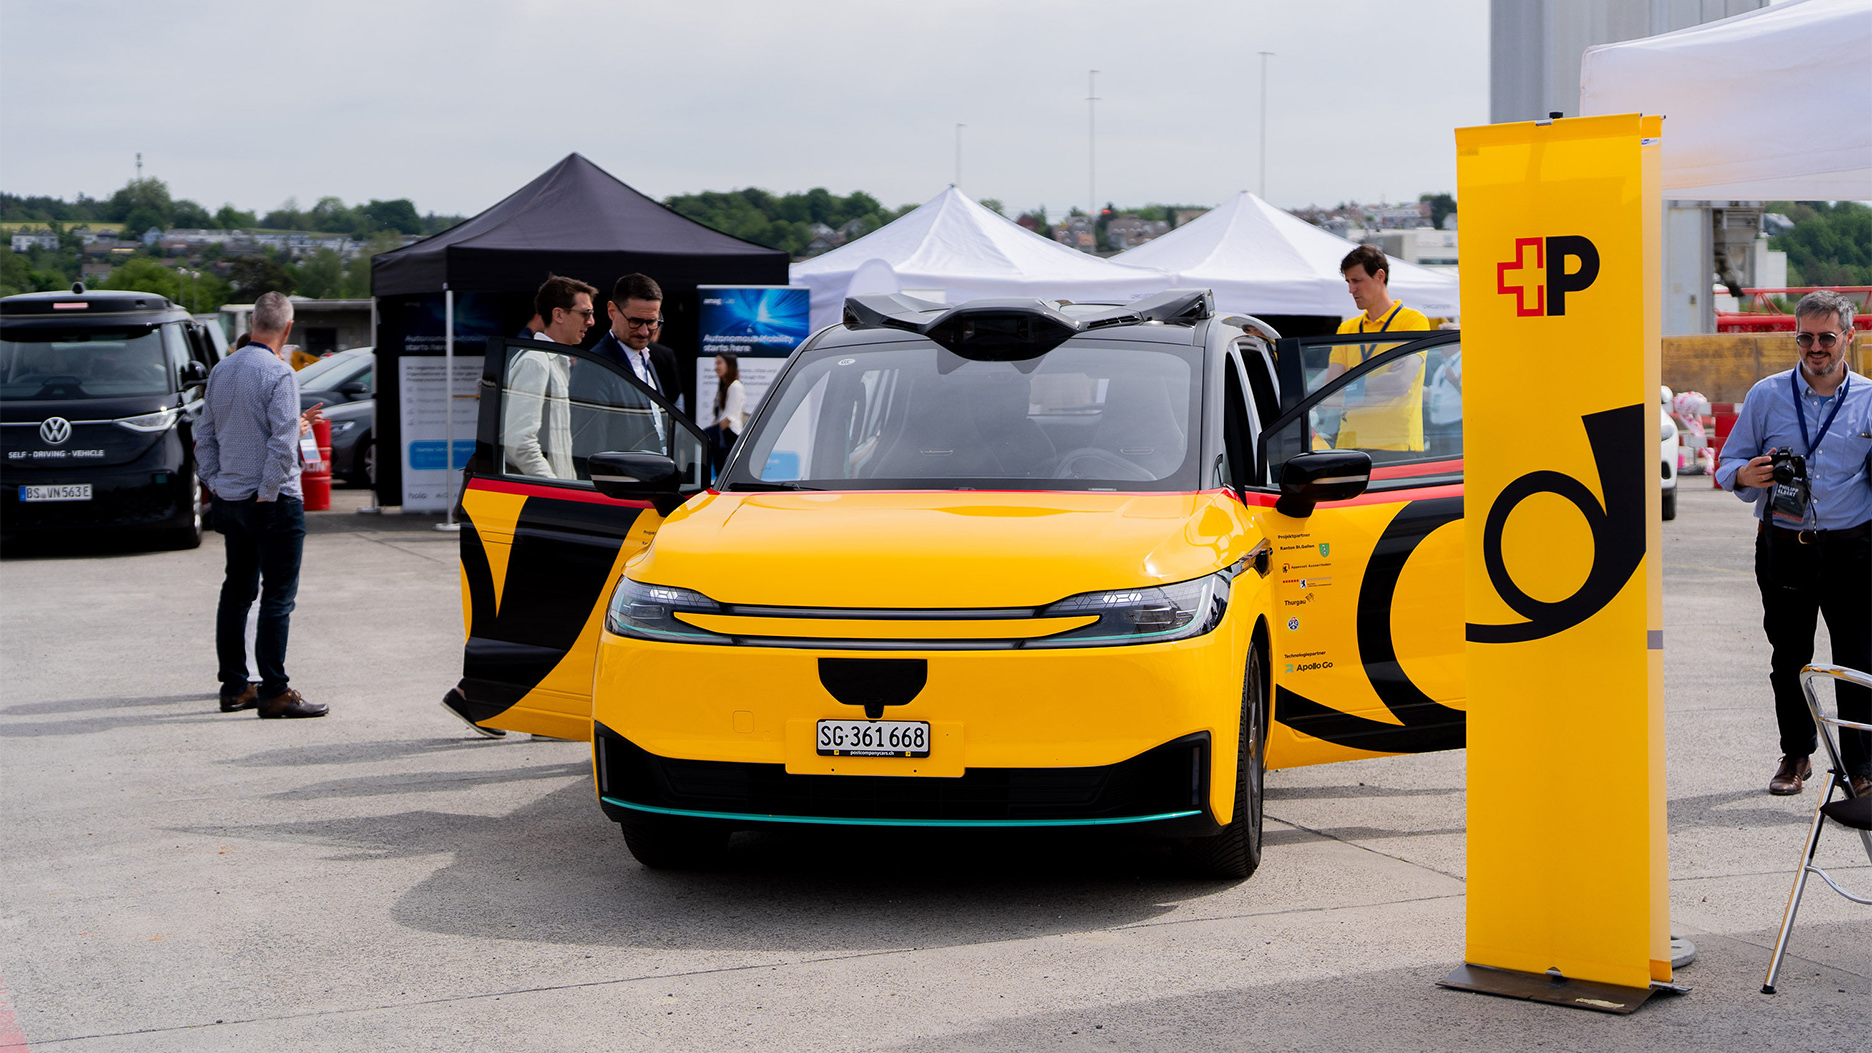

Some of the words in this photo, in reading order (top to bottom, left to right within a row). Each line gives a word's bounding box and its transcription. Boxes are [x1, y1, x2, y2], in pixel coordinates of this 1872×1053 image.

[1546, 235, 1600, 316] P
[703, 334, 758, 342] Autonomous
[759, 334, 794, 344] Mobility
[703, 344, 729, 352] starts
[730, 344, 752, 352] here
[8, 451, 27, 459] SELF
[33, 450, 65, 458] DRIVING
[72, 449, 104, 457] VEHICLE
[26, 487, 40, 499] BS
[1284, 650, 1326, 659] Technologiepartner
[1296, 662, 1321, 672] Apollo
[1322, 661, 1334, 669] Go
[889, 726, 925, 748] 668
